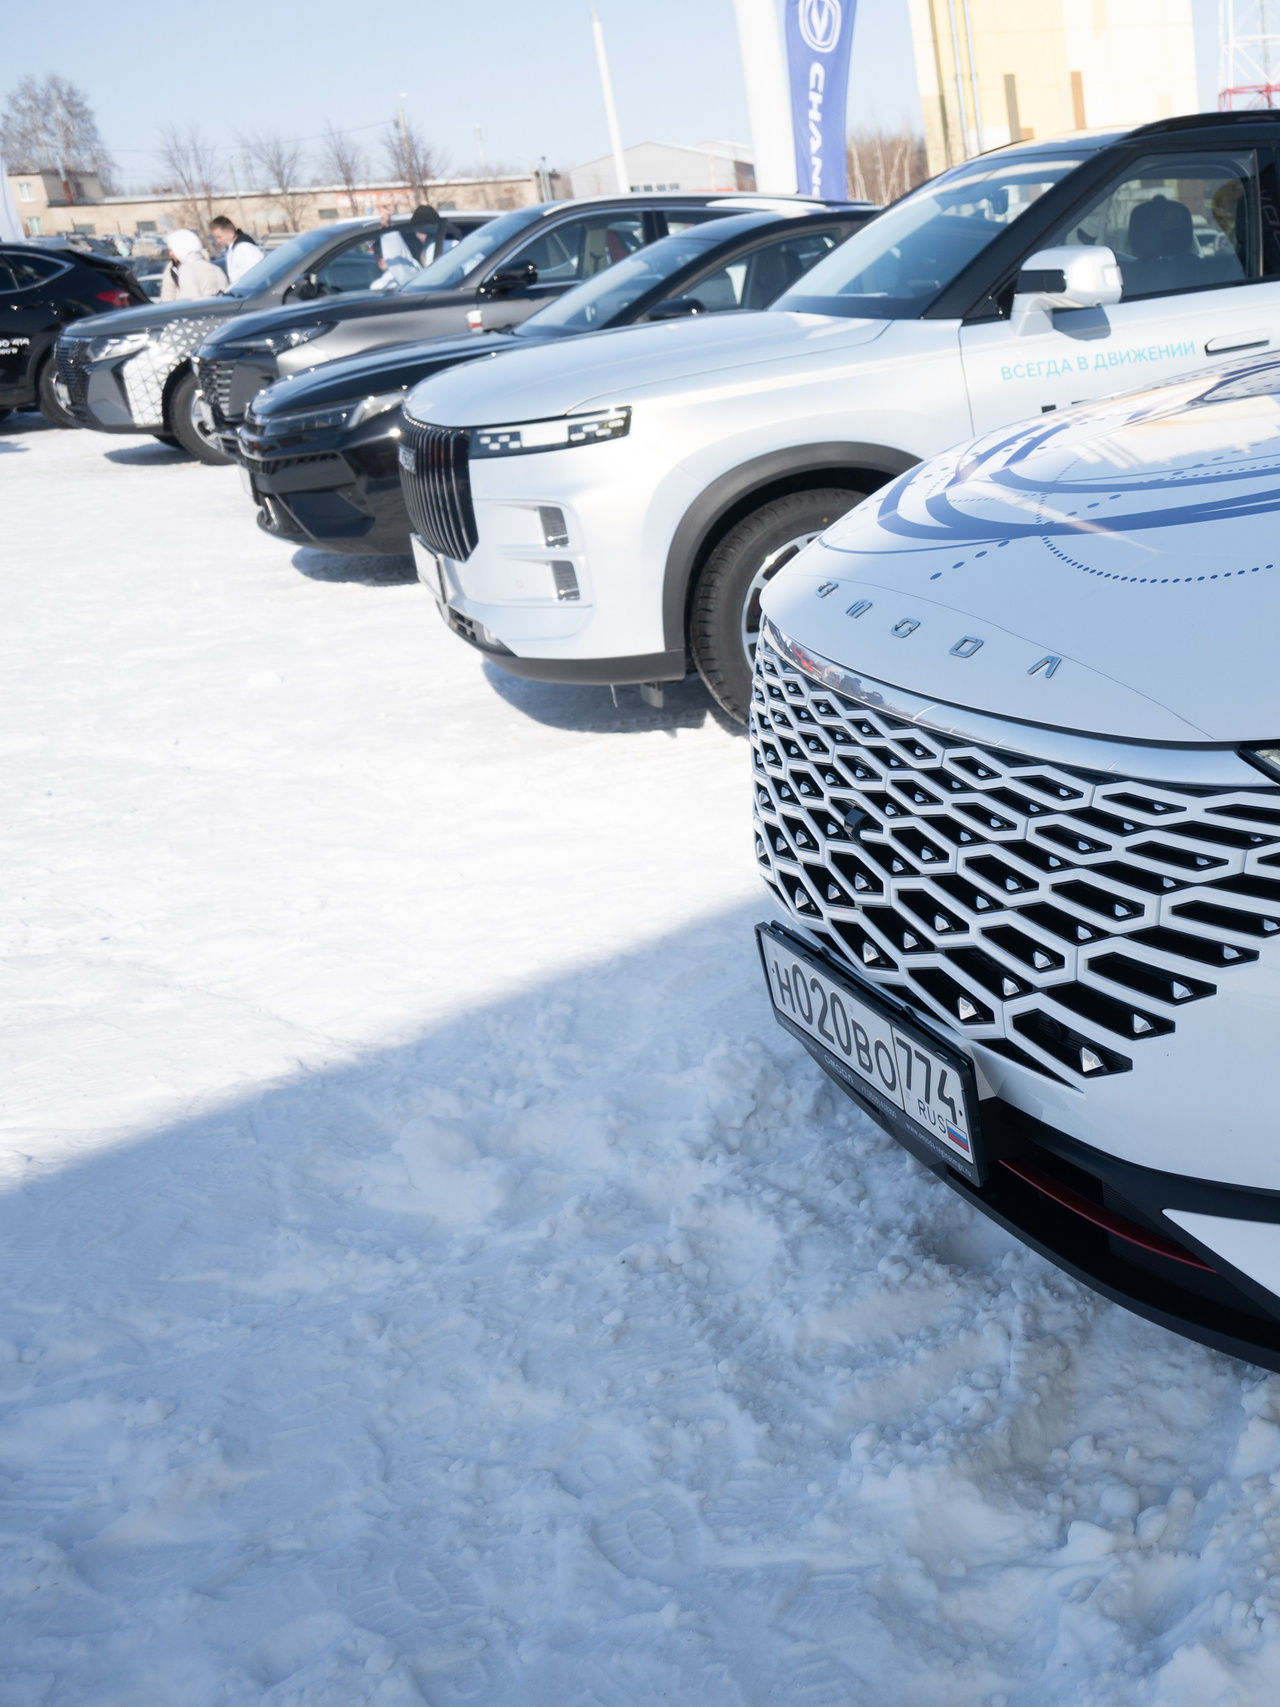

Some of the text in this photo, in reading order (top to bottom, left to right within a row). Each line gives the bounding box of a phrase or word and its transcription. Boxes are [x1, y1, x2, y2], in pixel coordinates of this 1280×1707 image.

[808, 62, 825, 198] CHAN
[1000, 341, 1197, 381] ВСЕГДА В ДВИЖЕНИИ
[815, 580, 1062, 678] OMODA
[896, 1036, 958, 1126] 774
[916, 1098, 947, 1134] RUS
